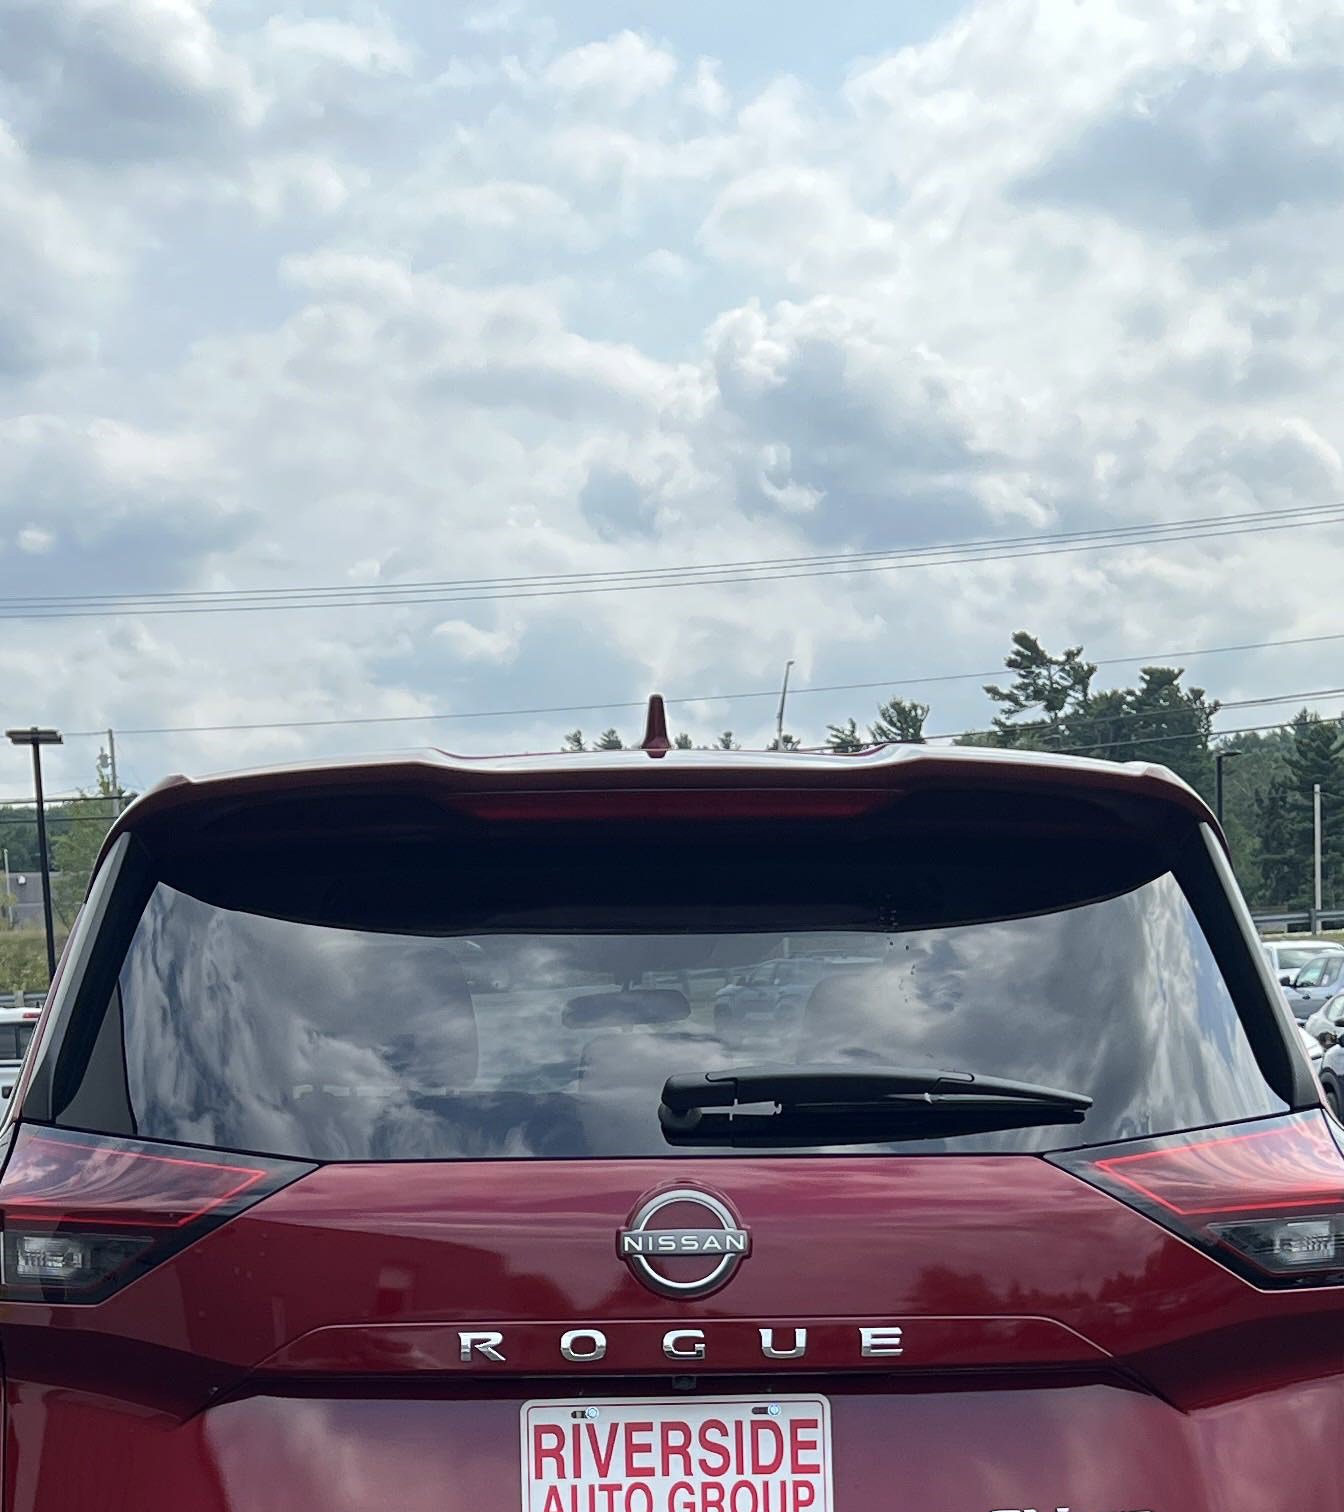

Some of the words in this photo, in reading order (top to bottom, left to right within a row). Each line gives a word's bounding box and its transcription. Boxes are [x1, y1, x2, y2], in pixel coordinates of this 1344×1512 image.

[622, 1233, 747, 1252] NISSAN
[457, 1326, 904, 1362] ROGUE
[533, 1418, 821, 1480] RIVERSIDE
